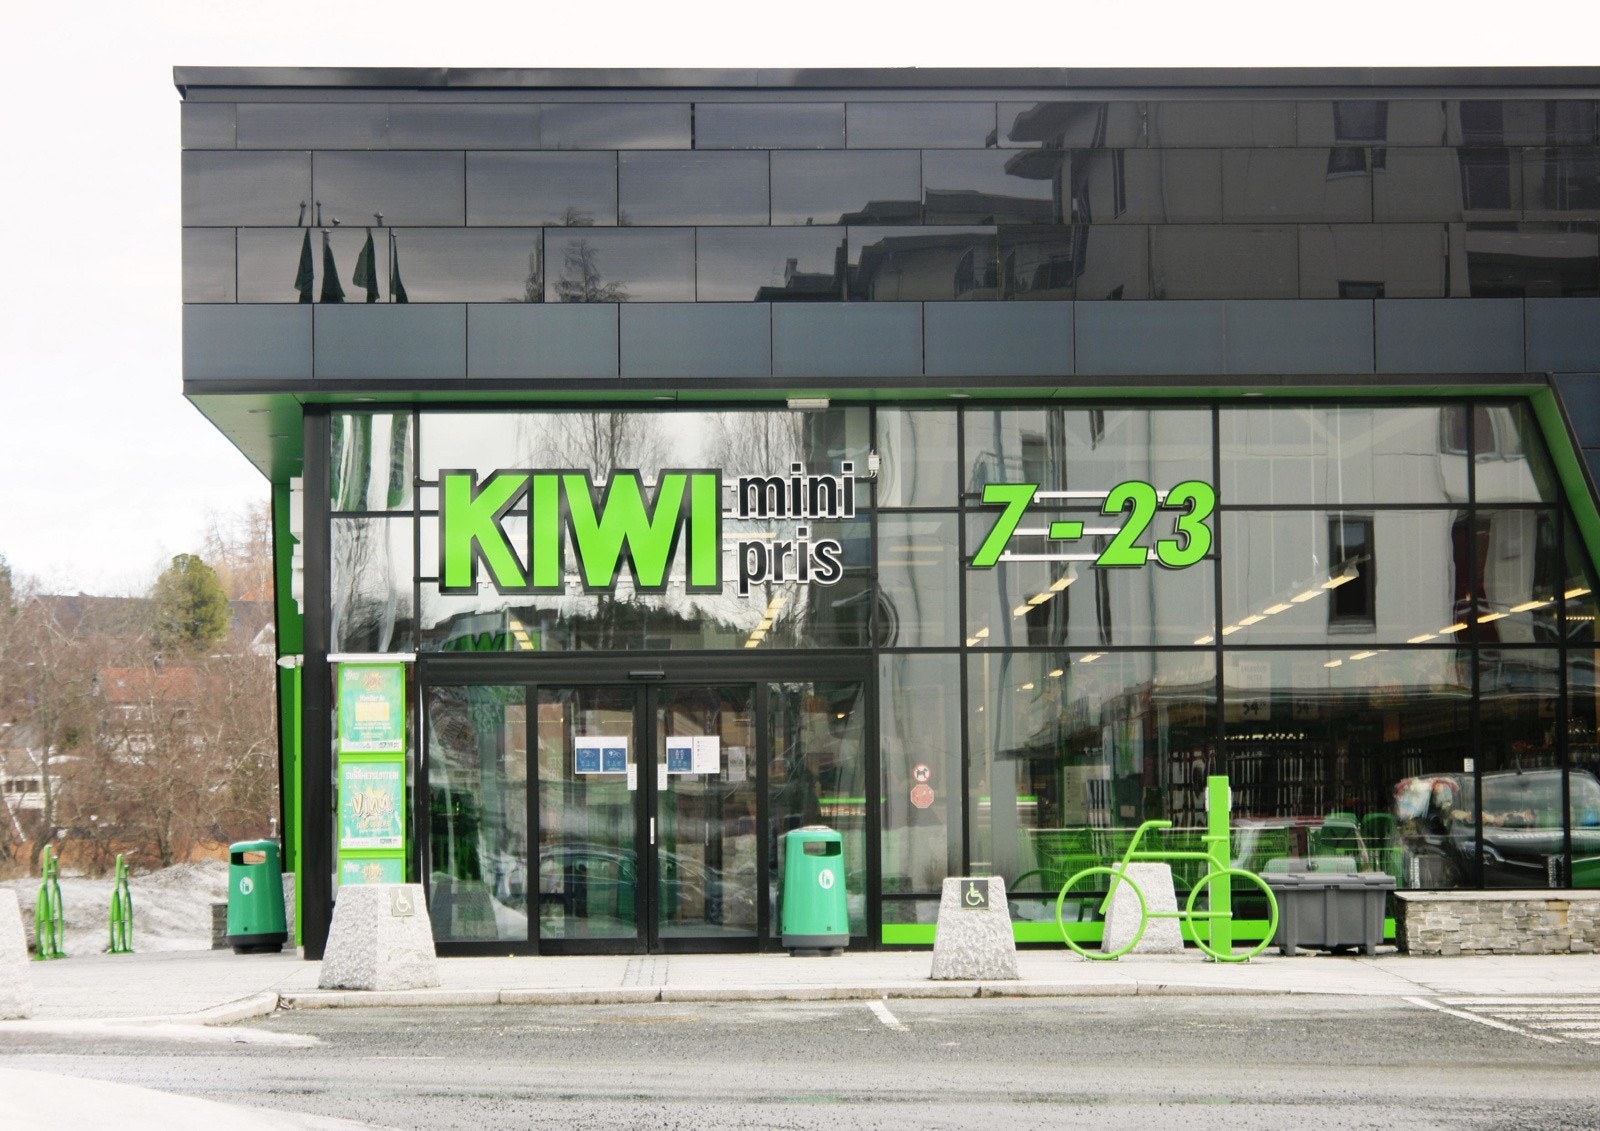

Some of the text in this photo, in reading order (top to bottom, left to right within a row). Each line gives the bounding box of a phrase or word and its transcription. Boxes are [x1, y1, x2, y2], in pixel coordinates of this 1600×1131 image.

[738, 462, 856, 519] mini
[438, 468, 723, 596] KIWI
[738, 526, 843, 597] pris
